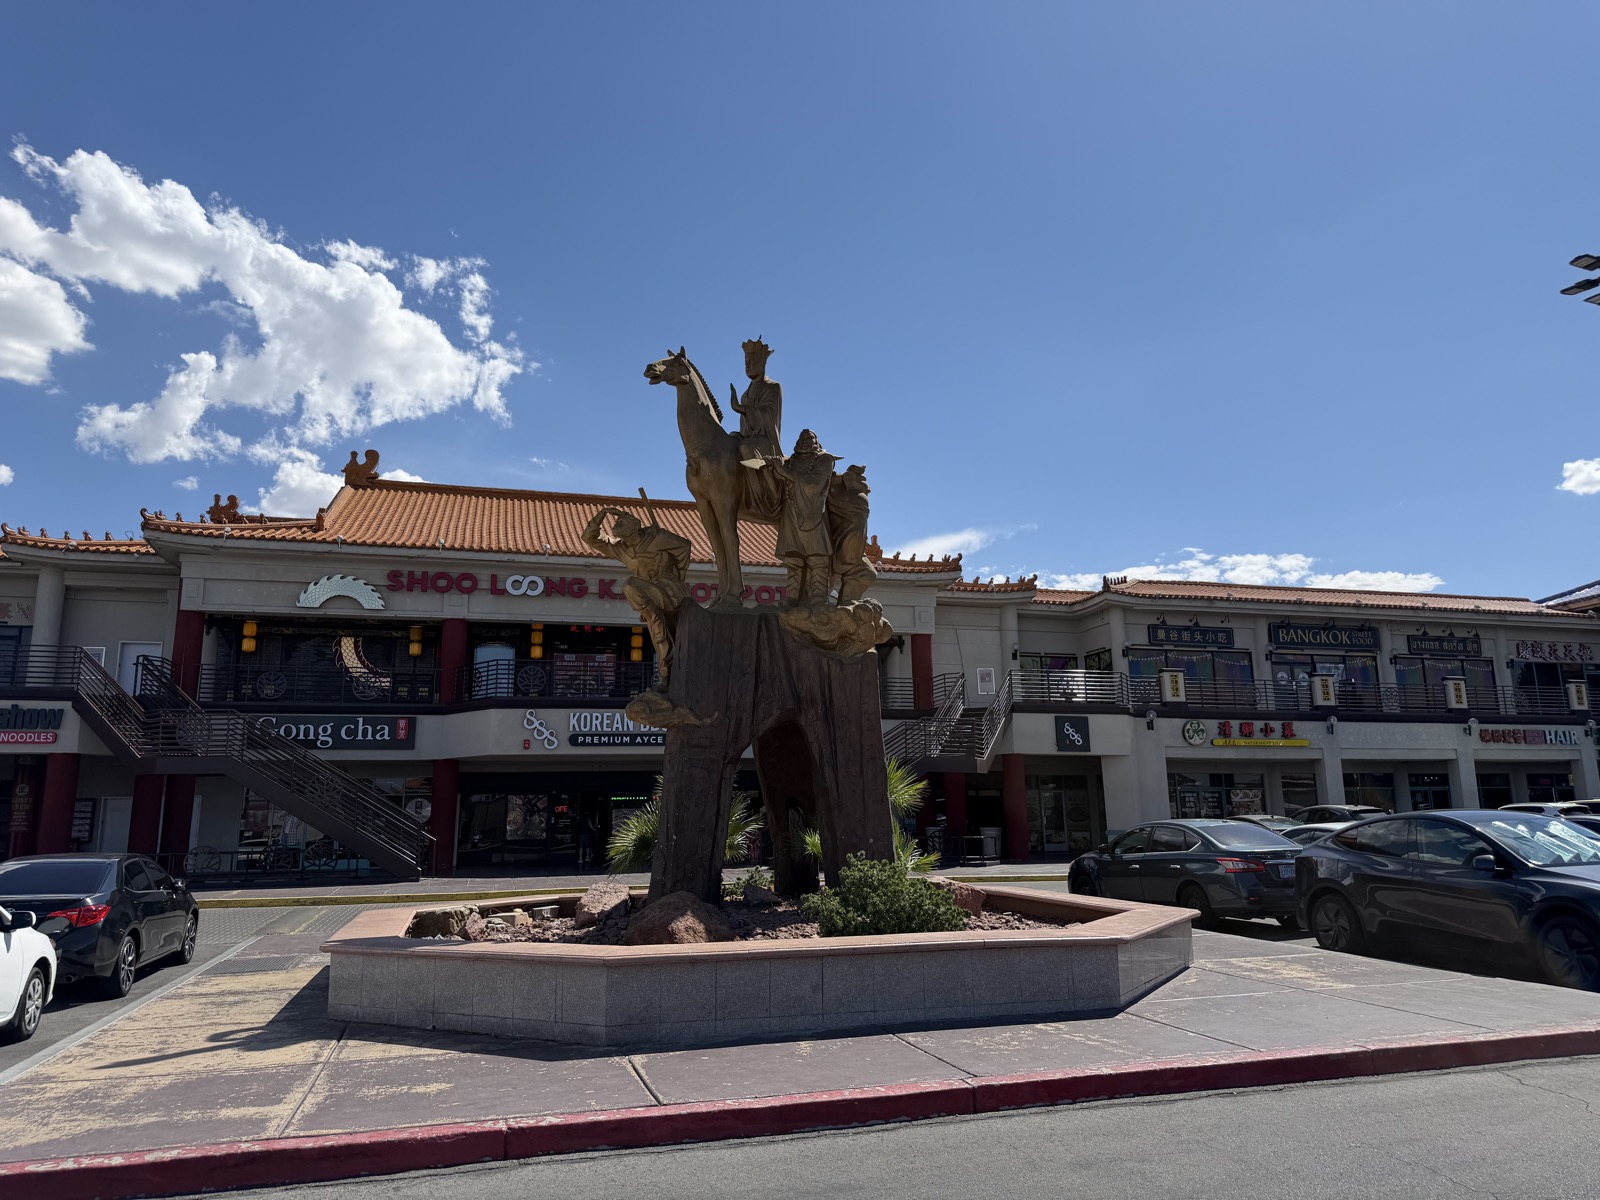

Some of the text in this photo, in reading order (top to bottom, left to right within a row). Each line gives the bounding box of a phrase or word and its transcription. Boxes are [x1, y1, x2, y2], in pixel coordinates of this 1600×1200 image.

[386, 570, 479, 594] SHOO
[1157, 629, 1227, 643] 曼谷街头小吃
[1279, 628, 1352, 644] BANGKOK
[1352, 637, 1373, 645] FOOD
[340, 717, 391, 740] cha
[524, 709, 559, 750] 888
[569, 712, 634, 732] KOREAN
[0, 733, 53, 742] NOODLES
[578, 736, 664, 744] PREMIUM AYCE
[1545, 730, 1579, 745] HAIR
